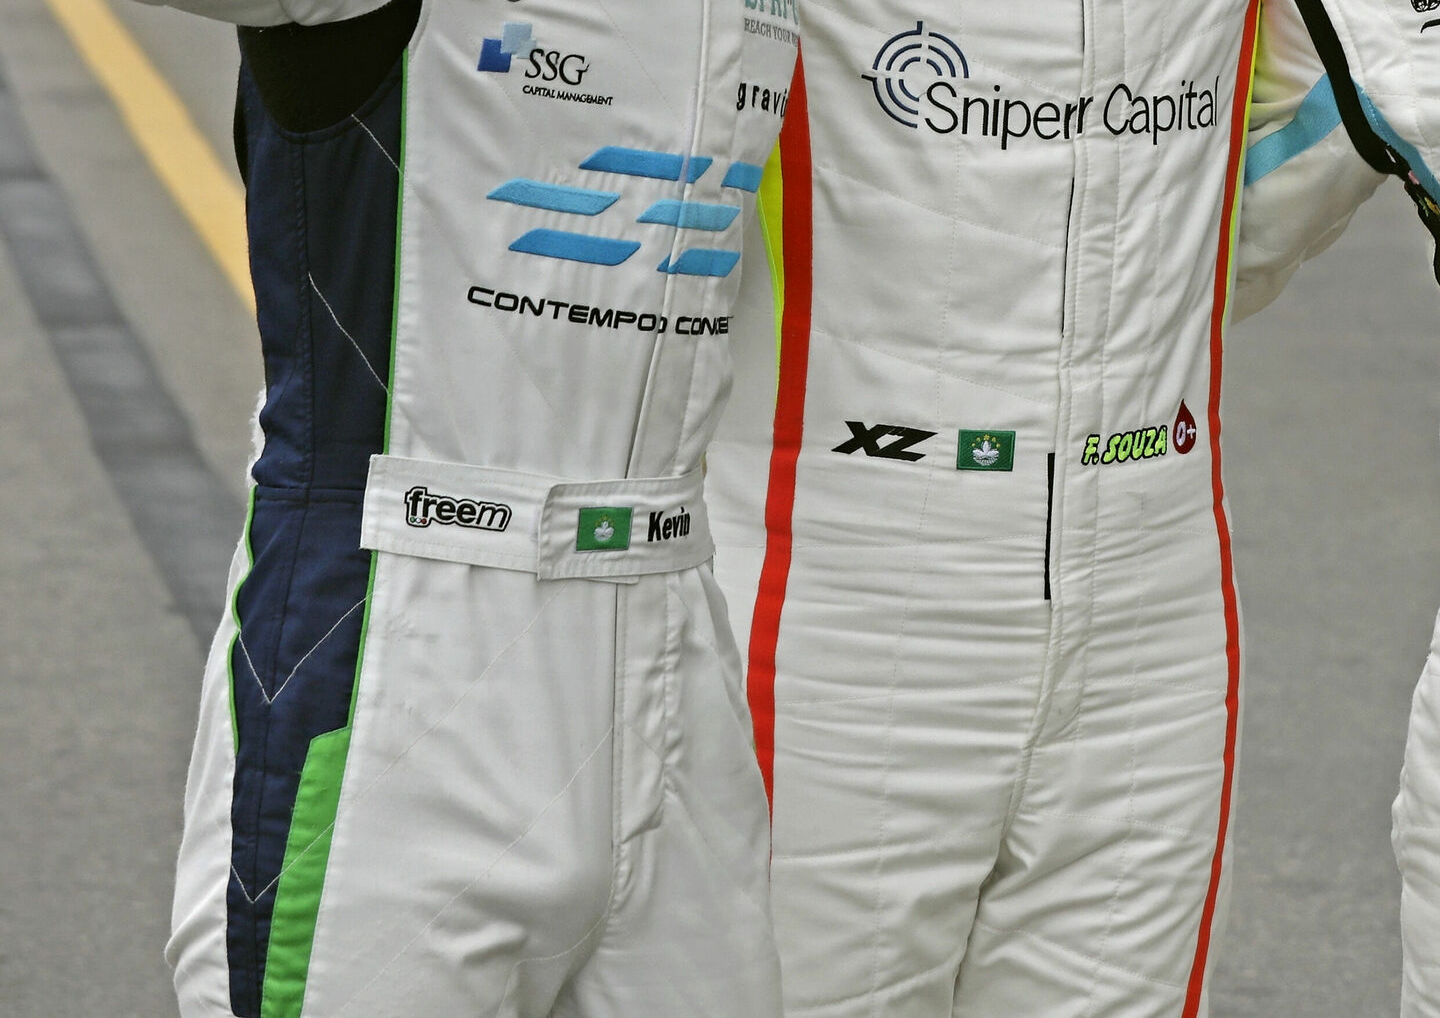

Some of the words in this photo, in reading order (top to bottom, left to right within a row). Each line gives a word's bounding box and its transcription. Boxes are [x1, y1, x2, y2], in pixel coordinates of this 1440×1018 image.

[525, 48, 590, 85] SSG
[522, 85, 555, 99] CAPITAL
[556, 90, 613, 106] MANAGEMENT
[1103, 75, 1220, 145] Capital
[831, 420, 938, 462] XZ
[1081, 434, 1100, 465] F.
[1101, 425, 1168, 464] SOUZA
[405, 486, 512, 532] freem
[648, 506, 690, 542] Kevin
